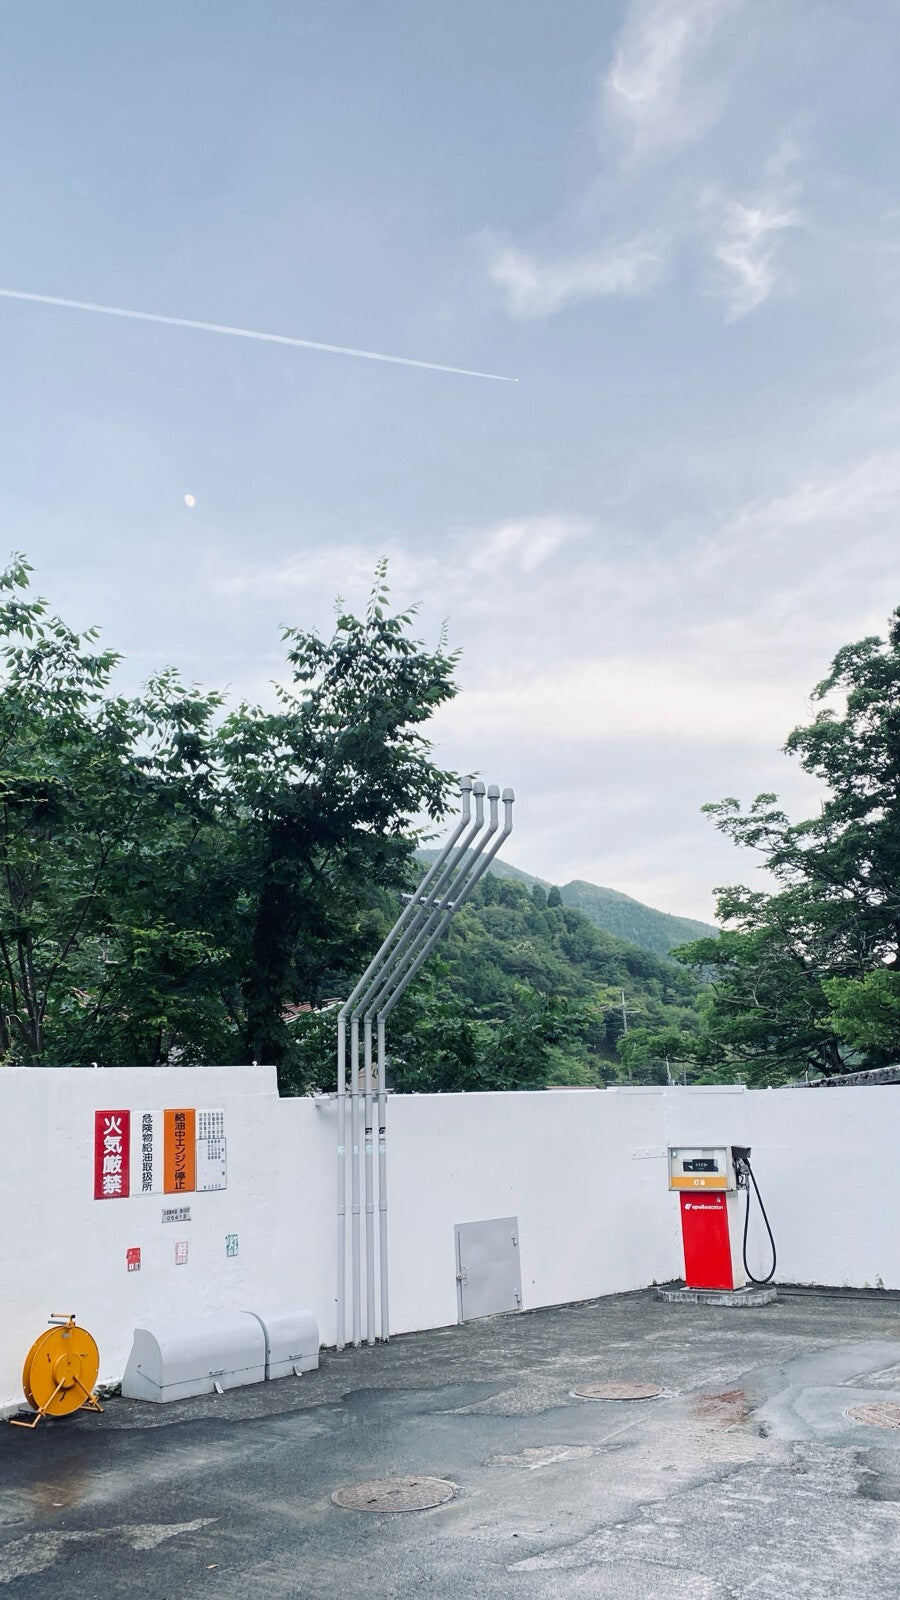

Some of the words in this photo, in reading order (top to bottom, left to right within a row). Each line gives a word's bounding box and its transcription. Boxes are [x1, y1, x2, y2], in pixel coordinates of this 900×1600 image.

[103, 1116, 122, 1194] 火気厳禁
[142, 1114, 153, 1191] 危険物給油取扱所
[174, 1113, 186, 1190] 給油中エンジン停止
